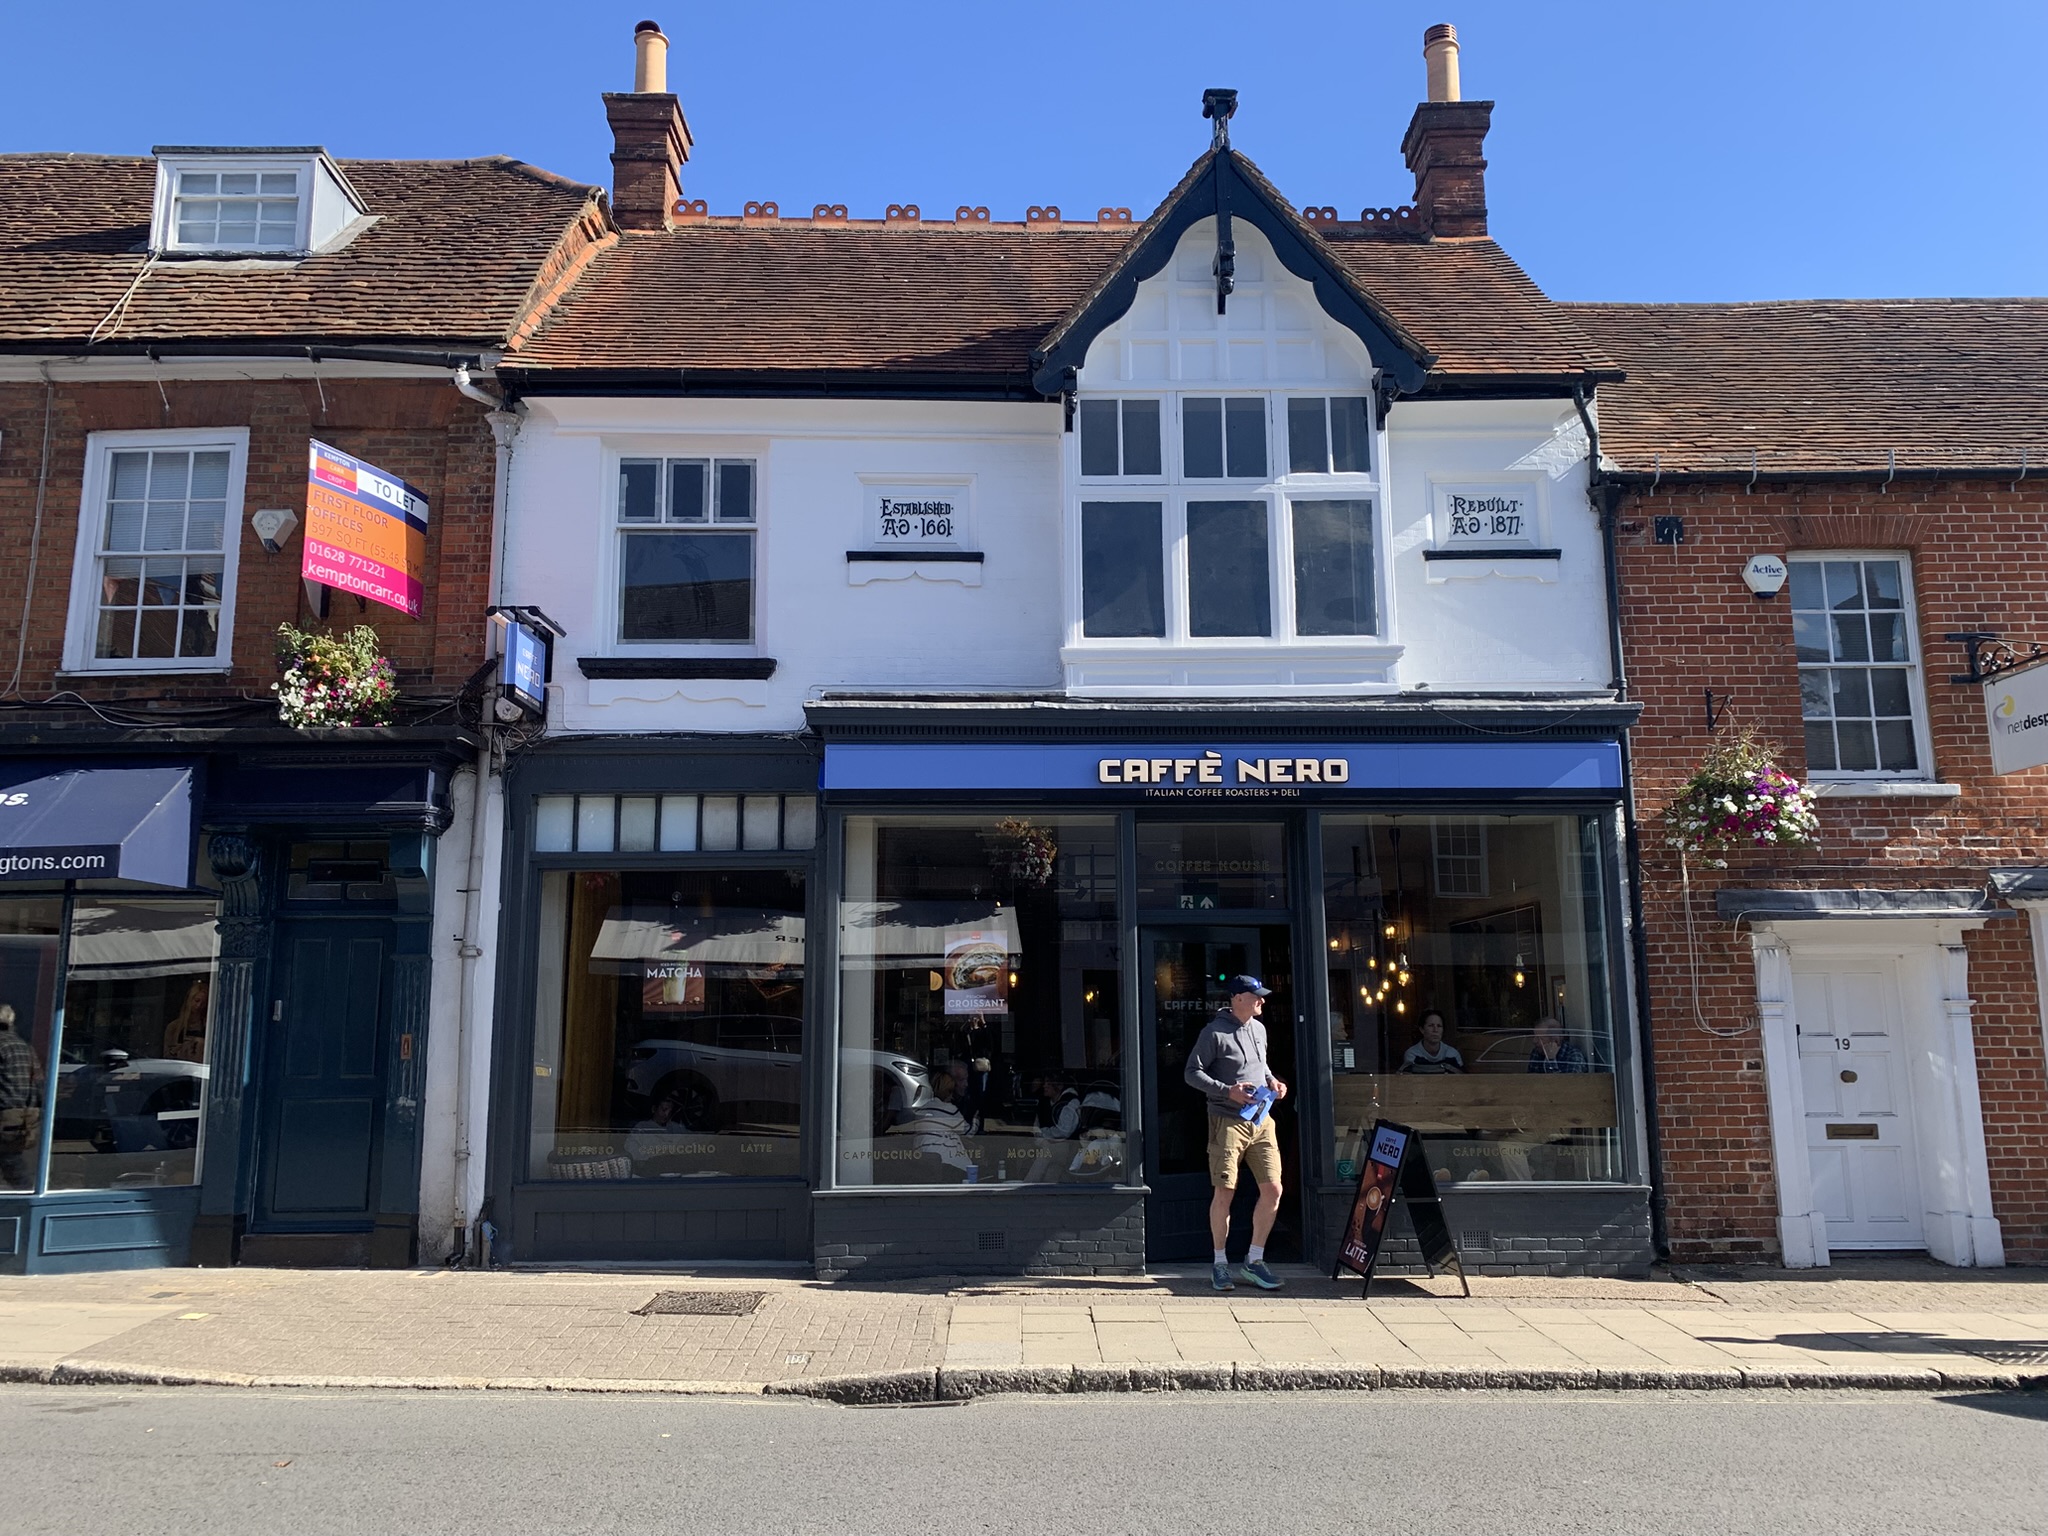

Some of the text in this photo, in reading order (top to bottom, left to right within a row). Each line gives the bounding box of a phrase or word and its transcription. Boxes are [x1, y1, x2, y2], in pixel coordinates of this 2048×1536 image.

[374, 479, 416, 512] TO LET
[312, 506, 364, 534] OFFICES
[313, 490, 388, 529] FIRST FLOOR
[311, 521, 333, 538] 597
[336, 530, 351, 549] SQ
[355, 537, 368, 551] FT
[920, 517, 952, 538] 1661
[1490, 515, 1520, 536] 1877
[309, 541, 386, 579] 01628 771221
[1752, 564, 1783, 574] Active
[307, 559, 419, 614] kemptoncarr.co.uk
[517, 660, 541, 687] NERO
[1098, 749, 1350, 784] CAFFÈ NERO
[1145, 788, 1184, 797] ITALIAN
[1186, 788, 1223, 797] COFFEE
[1225, 788, 1270, 797] ROASTERS
[1281, 788, 1301, 797] DELI
[1154, 860, 1270, 872] COFFEE HOUSE
[646, 967, 703, 978] MATCHA
[947, 998, 1006, 1008] CROISSANT
[1834, 1037, 1850, 1050] 19
[557, 1143, 773, 1155] ESPRESSO CAPPUCCINO LATTE
[843, 1149, 923, 1160] CAPPUCCINO
[1007, 1148, 1053, 1159] MOCHA
[1376, 1141, 1400, 1159] NERO
[1453, 1147, 1531, 1157] CAPPUCCINO
[1345, 1242, 1368, 1263] LATTE
